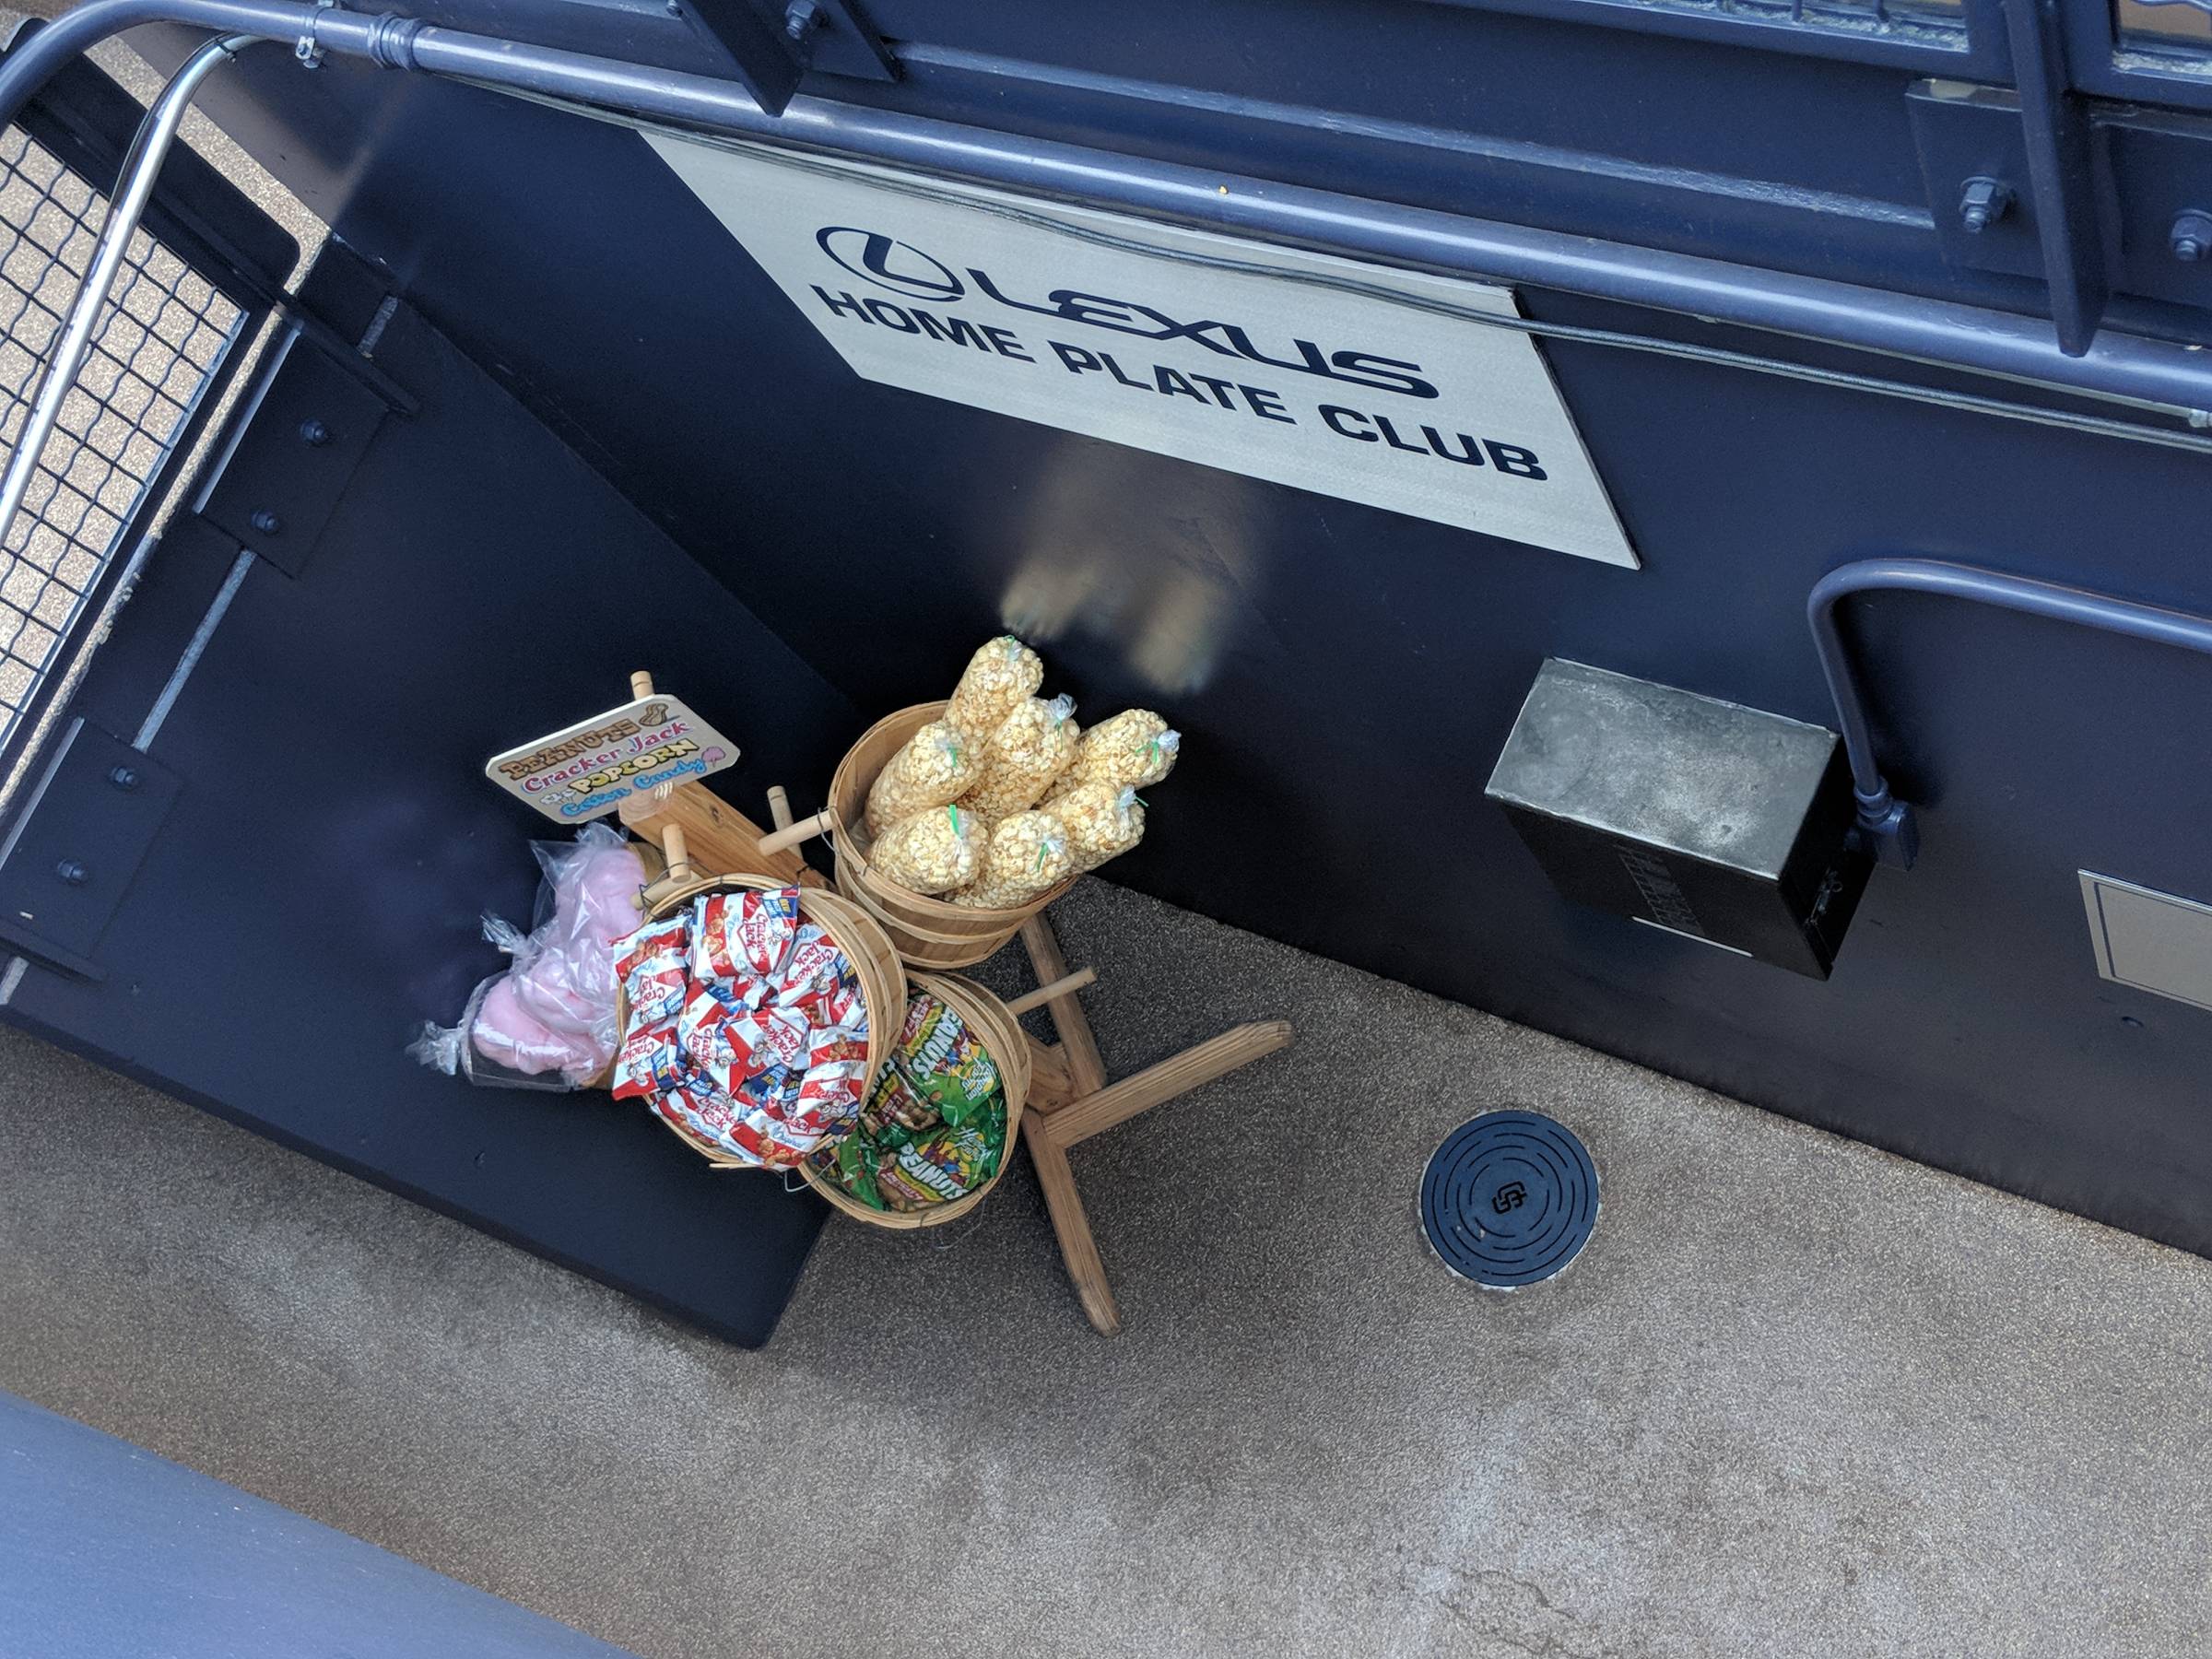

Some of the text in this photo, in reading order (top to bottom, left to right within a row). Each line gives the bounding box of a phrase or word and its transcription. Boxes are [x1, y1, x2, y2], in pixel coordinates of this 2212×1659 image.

[965, 267, 1440, 399] LEXUS
[809, 283, 1548, 481] HOME PLATE CLUB
[499, 718, 641, 781] PEANUTS
[522, 721, 697, 794] Cracker Jack
[567, 737, 700, 794] POPCORN
[559, 758, 707, 817] Cotton Candy
[742, 918, 757, 948] Jack
[794, 940, 820, 966] Jack
[794, 948, 834, 985] Cracker
[702, 1027, 714, 1070] Cracke
[761, 1022, 794, 1064] Cracker
[698, 1095, 737, 1125] Cracke
[898, 1141, 969, 1200] PEANUTS
